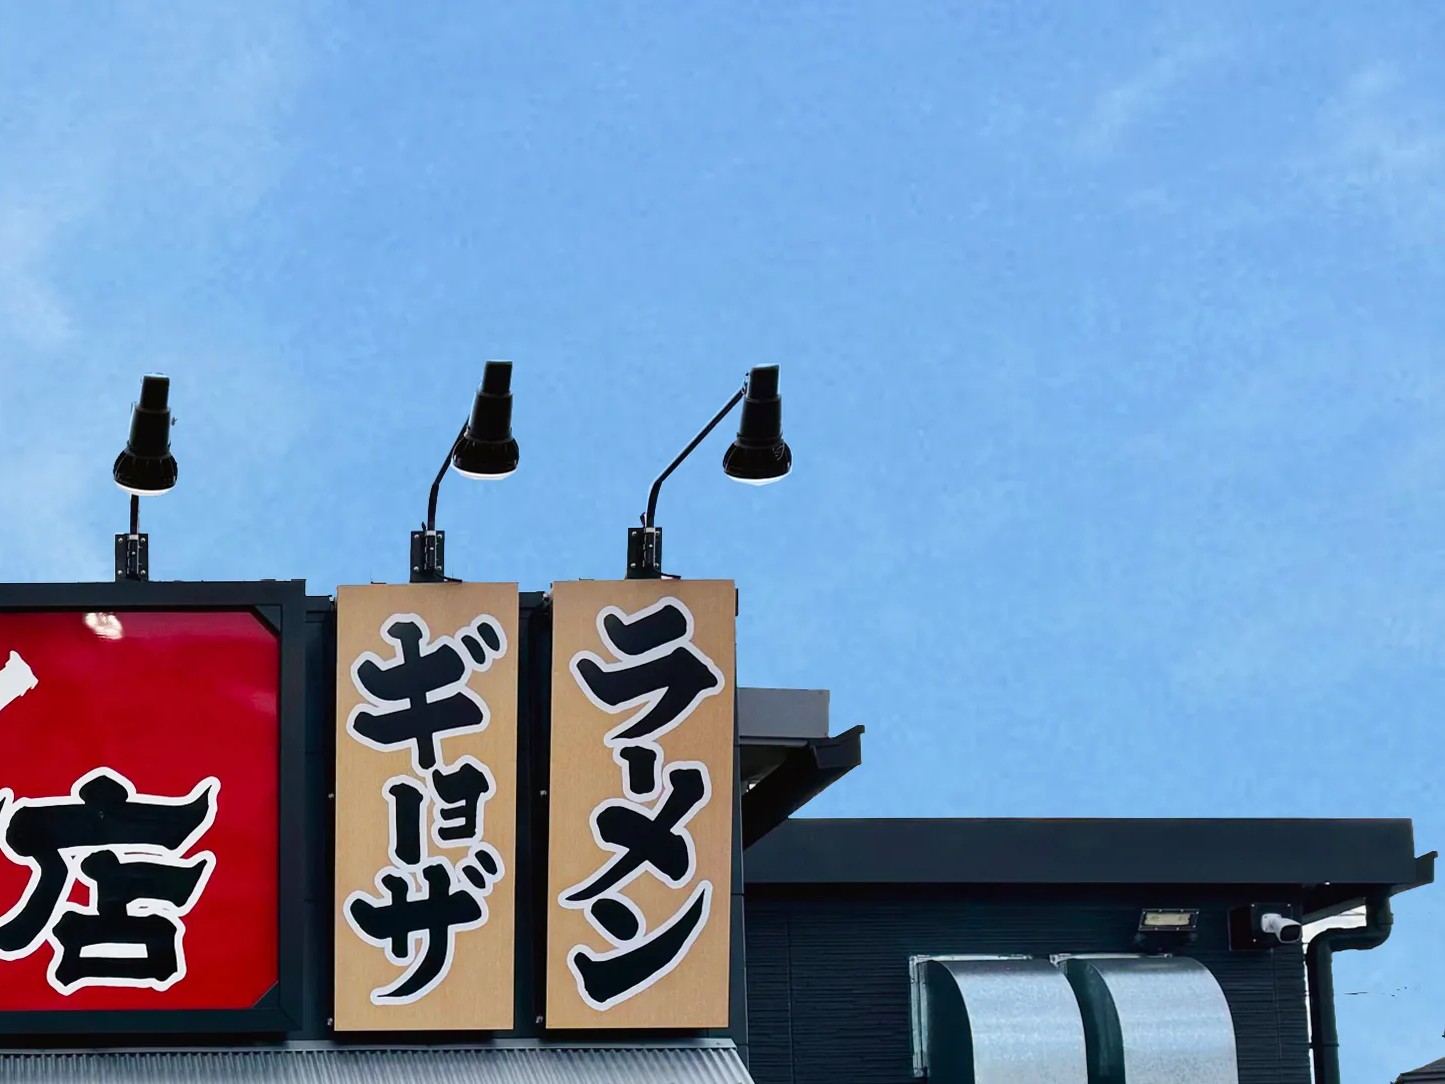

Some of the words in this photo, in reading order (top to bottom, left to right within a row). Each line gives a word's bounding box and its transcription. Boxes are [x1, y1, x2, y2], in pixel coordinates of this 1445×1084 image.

[343, 612, 507, 1006] ギョーザ
[558, 596, 726, 1011] ラーメン
